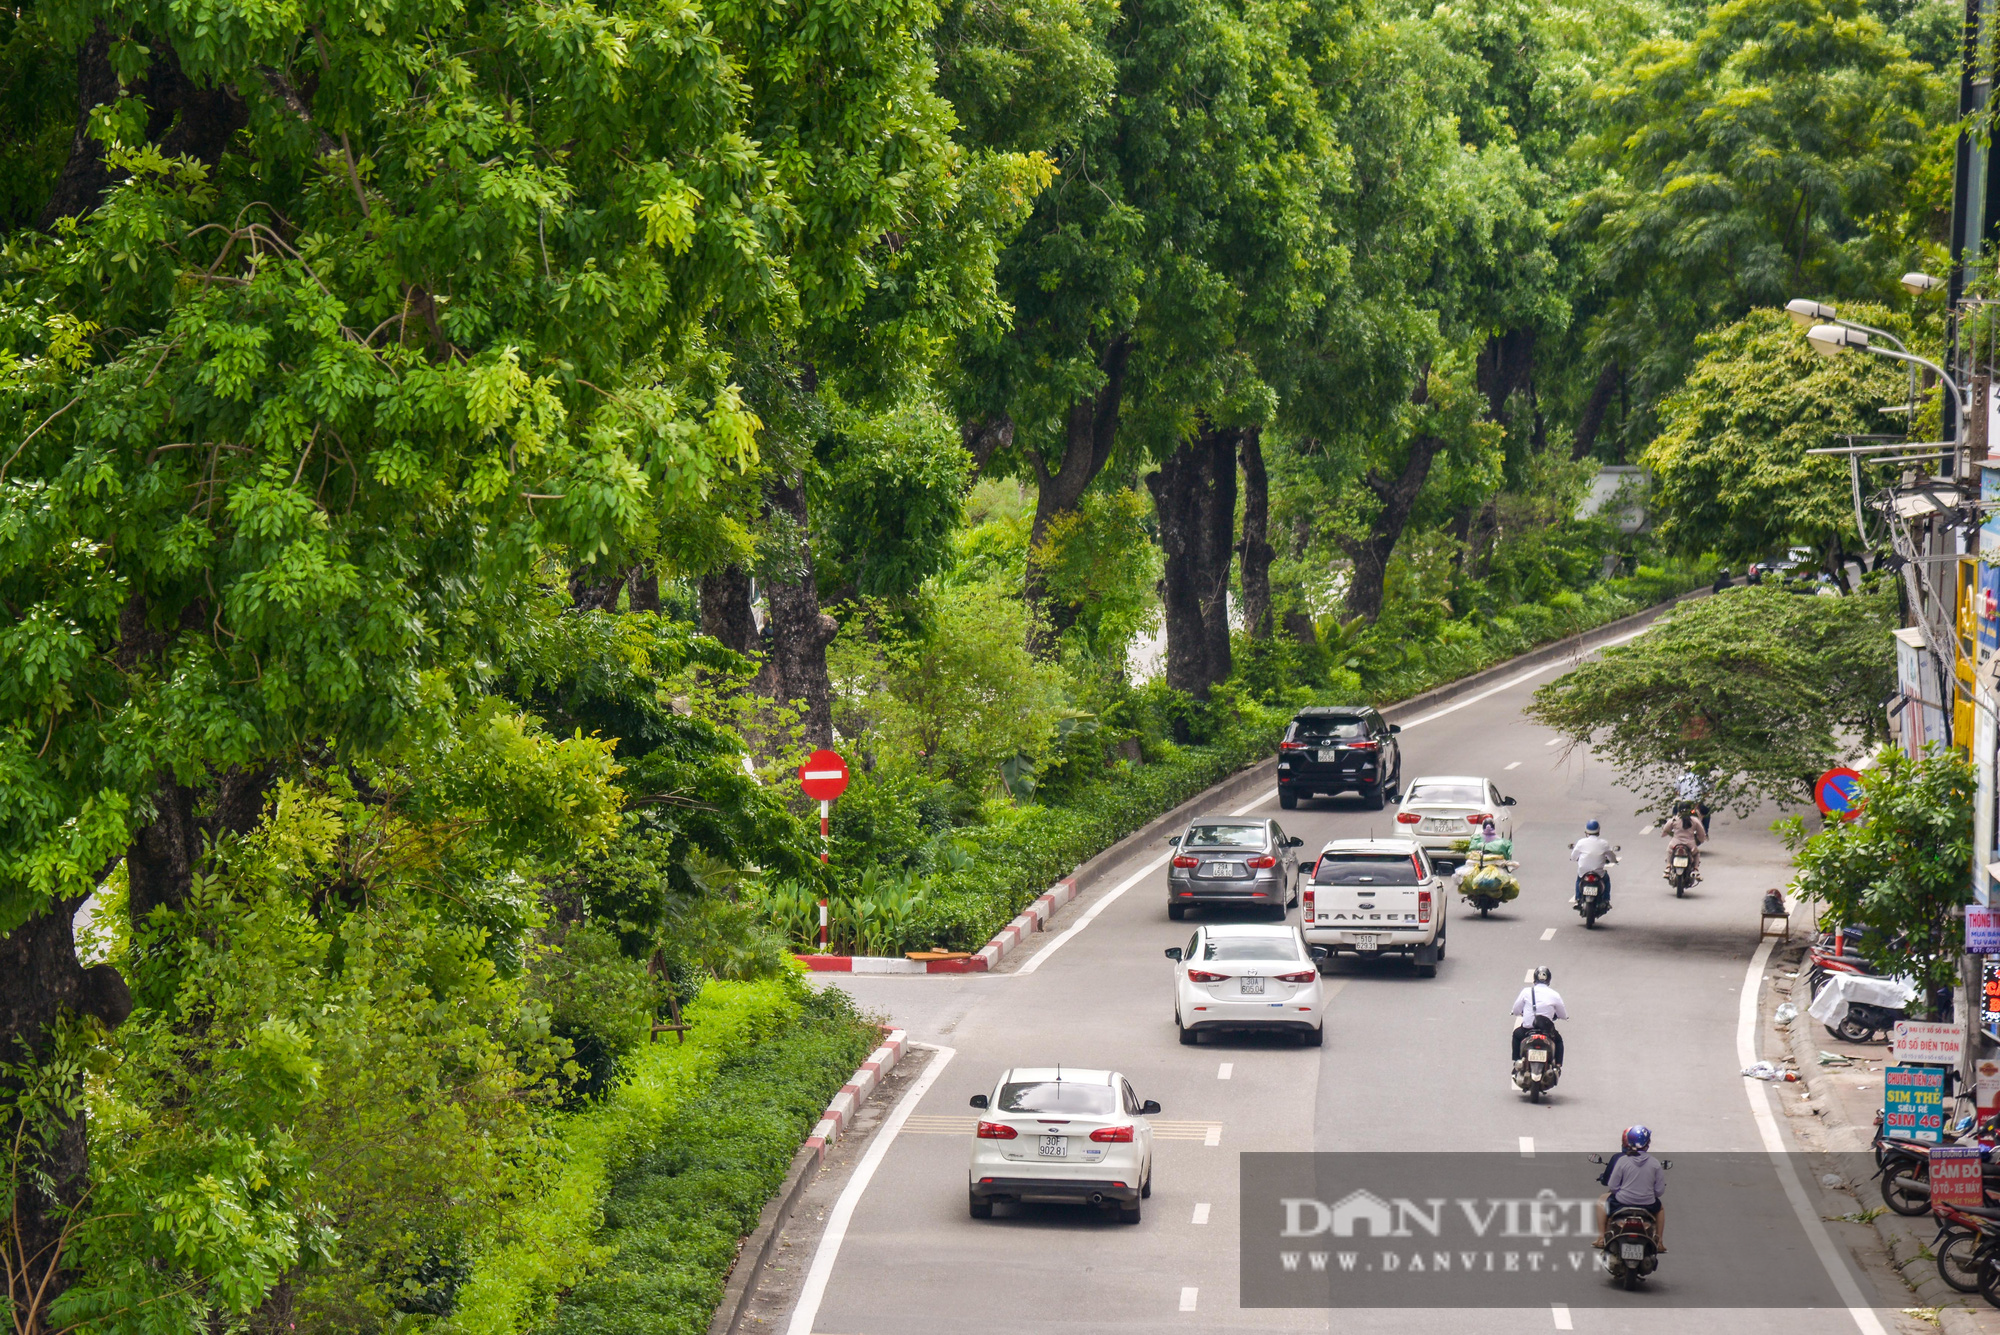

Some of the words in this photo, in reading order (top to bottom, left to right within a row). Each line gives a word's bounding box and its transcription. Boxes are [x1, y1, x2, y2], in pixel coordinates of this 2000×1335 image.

[1242, 985, 1263, 993] 605.04
[1897, 1035, 1906, 1049] XỔ
[1909, 1037, 1919, 1050] SỐ
[1920, 1039, 1938, 1052] ĐIỆN
[1940, 1040, 1959, 1052] TOÁN
[1887, 1090, 1911, 1103] SIM
[1914, 1088, 1941, 1104] THẺ
[1887, 1113, 1915, 1126] SIM
[1919, 1115, 1940, 1128] 4G
[1046, 1136, 1060, 1145] 30F
[1040, 1145, 1066, 1156] 902.81
[1931, 1159, 1959, 1178] CẦM
[1962, 1158, 1981, 1178] ĐỒ
[1932, 1181, 1939, 1194] Ô
[1940, 1181, 1950, 1194] TÔ
[1954, 1183, 1964, 1194] XE
[1965, 1180, 1980, 1194] MÁY
